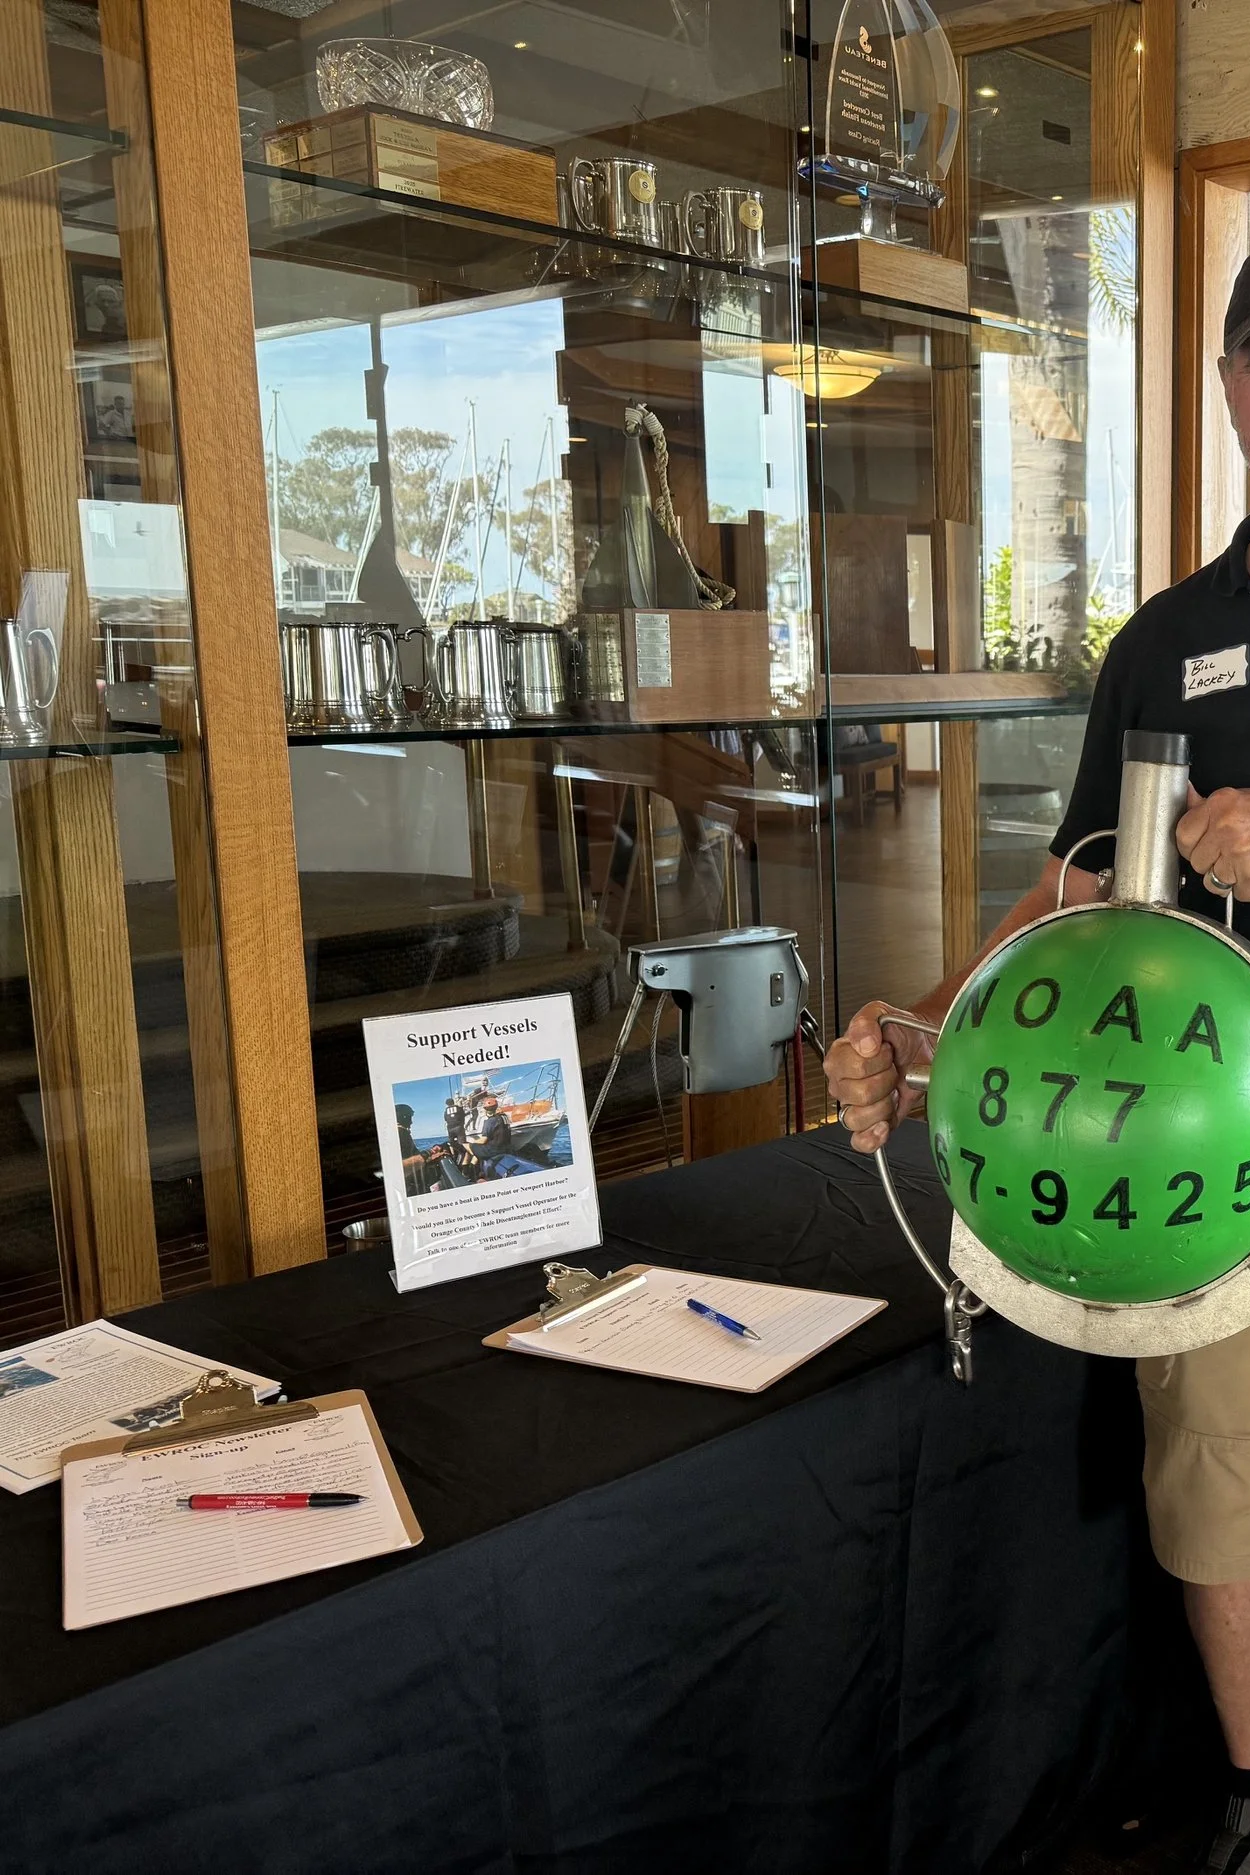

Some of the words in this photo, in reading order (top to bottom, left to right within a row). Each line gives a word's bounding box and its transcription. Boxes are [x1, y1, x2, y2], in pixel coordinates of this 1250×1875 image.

[955, 977, 1224, 1065] NOAA
[407, 1027, 477, 1049] Support
[481, 1018, 538, 1038] Vessels
[442, 1044, 510, 1068] Needed!
[978, 1067, 1146, 1143] 877
[497, 1189, 512, 1197] Point
[520, 1183, 544, 1193] Newport
[433, 1220, 444, 1228] you
[491, 1205, 514, 1215] Support
[431, 1230, 454, 1238] Orange
[454, 1225, 475, 1233] County
[520, 1226, 545, 1235] members
[141, 1442, 211, 1462] EWROC
[215, 1426, 293, 1448] Newsletter
[189, 1445, 249, 1461] Sign-up
